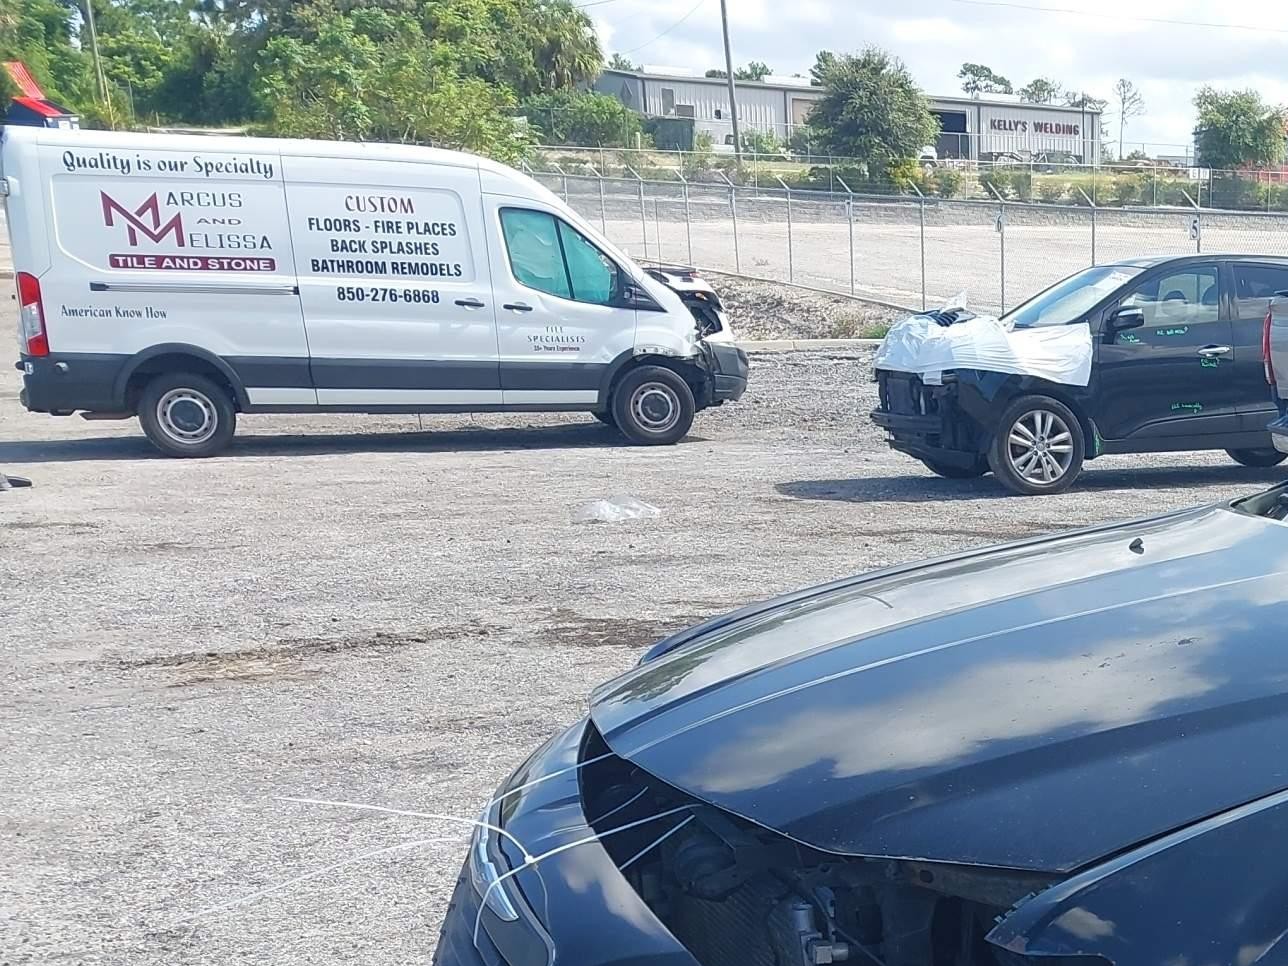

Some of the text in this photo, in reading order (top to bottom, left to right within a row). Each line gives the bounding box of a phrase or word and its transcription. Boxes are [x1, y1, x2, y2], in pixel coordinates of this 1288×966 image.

[990, 118, 1080, 136] KELLY'S WELDING
[62, 150, 274, 180] Quality is our Specialty
[345, 195, 415, 214] CUSTOM
[196, 217, 242, 226] AND
[308, 217, 361, 233] FLOORS
[373, 220, 403, 235] FIRE
[406, 222, 457, 237] PLACES
[1191, 219, 1198, 239] 5
[330, 239, 440, 256] BACK SPLASHES
[114, 256, 272, 271] TILE AND STONE
[311, 259, 462, 277] BATHROOM REMODELS
[337, 286, 440, 304] 850-276-6868
[61, 304, 167, 319] American Know How
[527, 335, 585, 343] SPECIALISTS
